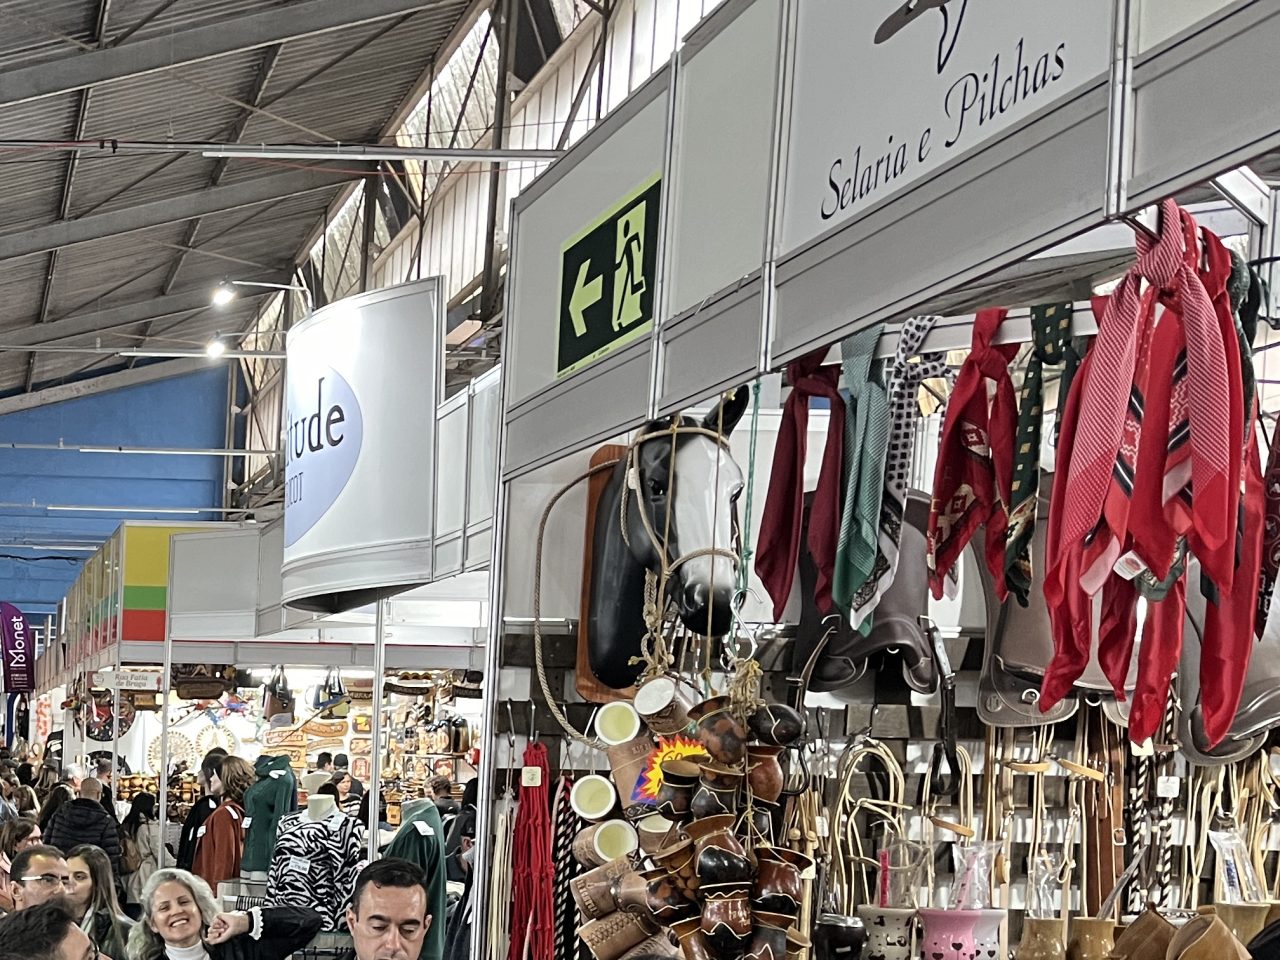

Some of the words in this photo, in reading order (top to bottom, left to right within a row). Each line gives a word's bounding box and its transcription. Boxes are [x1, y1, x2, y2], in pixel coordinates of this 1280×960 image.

[820, 135, 908, 220] Selaria
[919, 128, 932, 163] e
[944, 37, 1066, 149] Pilchas
[8, 615, 26, 667] Monet
